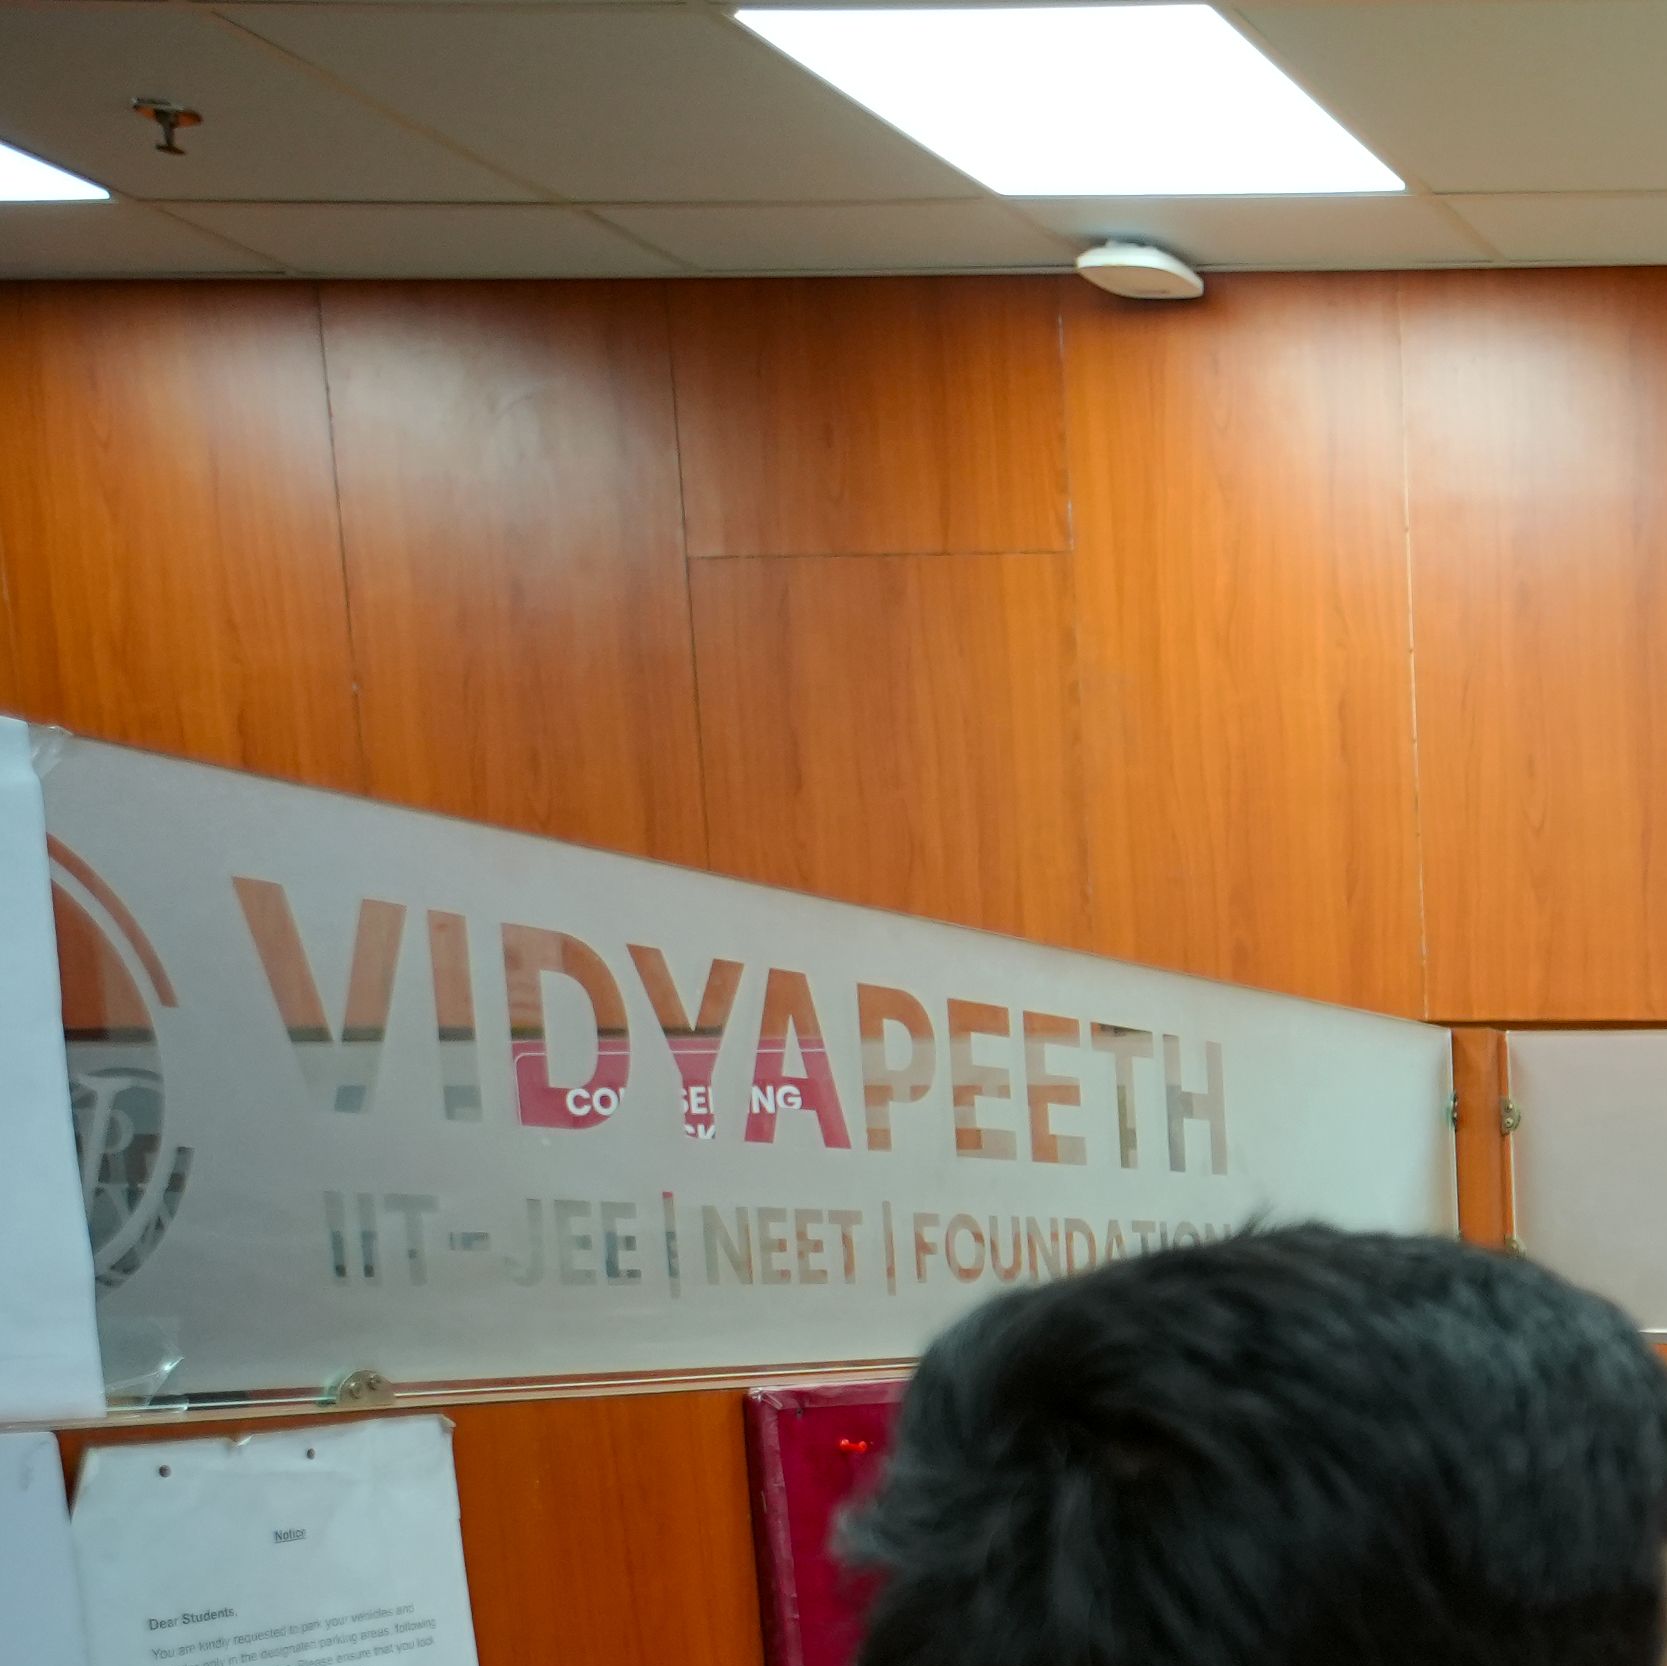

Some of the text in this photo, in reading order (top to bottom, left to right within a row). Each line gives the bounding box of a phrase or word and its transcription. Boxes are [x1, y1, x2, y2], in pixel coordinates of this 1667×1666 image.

[232, 875, 1228, 1175] VIDYAPEETH
[703, 1205, 863, 1285] NEET
[148, 1616, 176, 1630] Dear
[152, 1646, 174, 1660] You
[232, 1626, 286, 1647] requested
